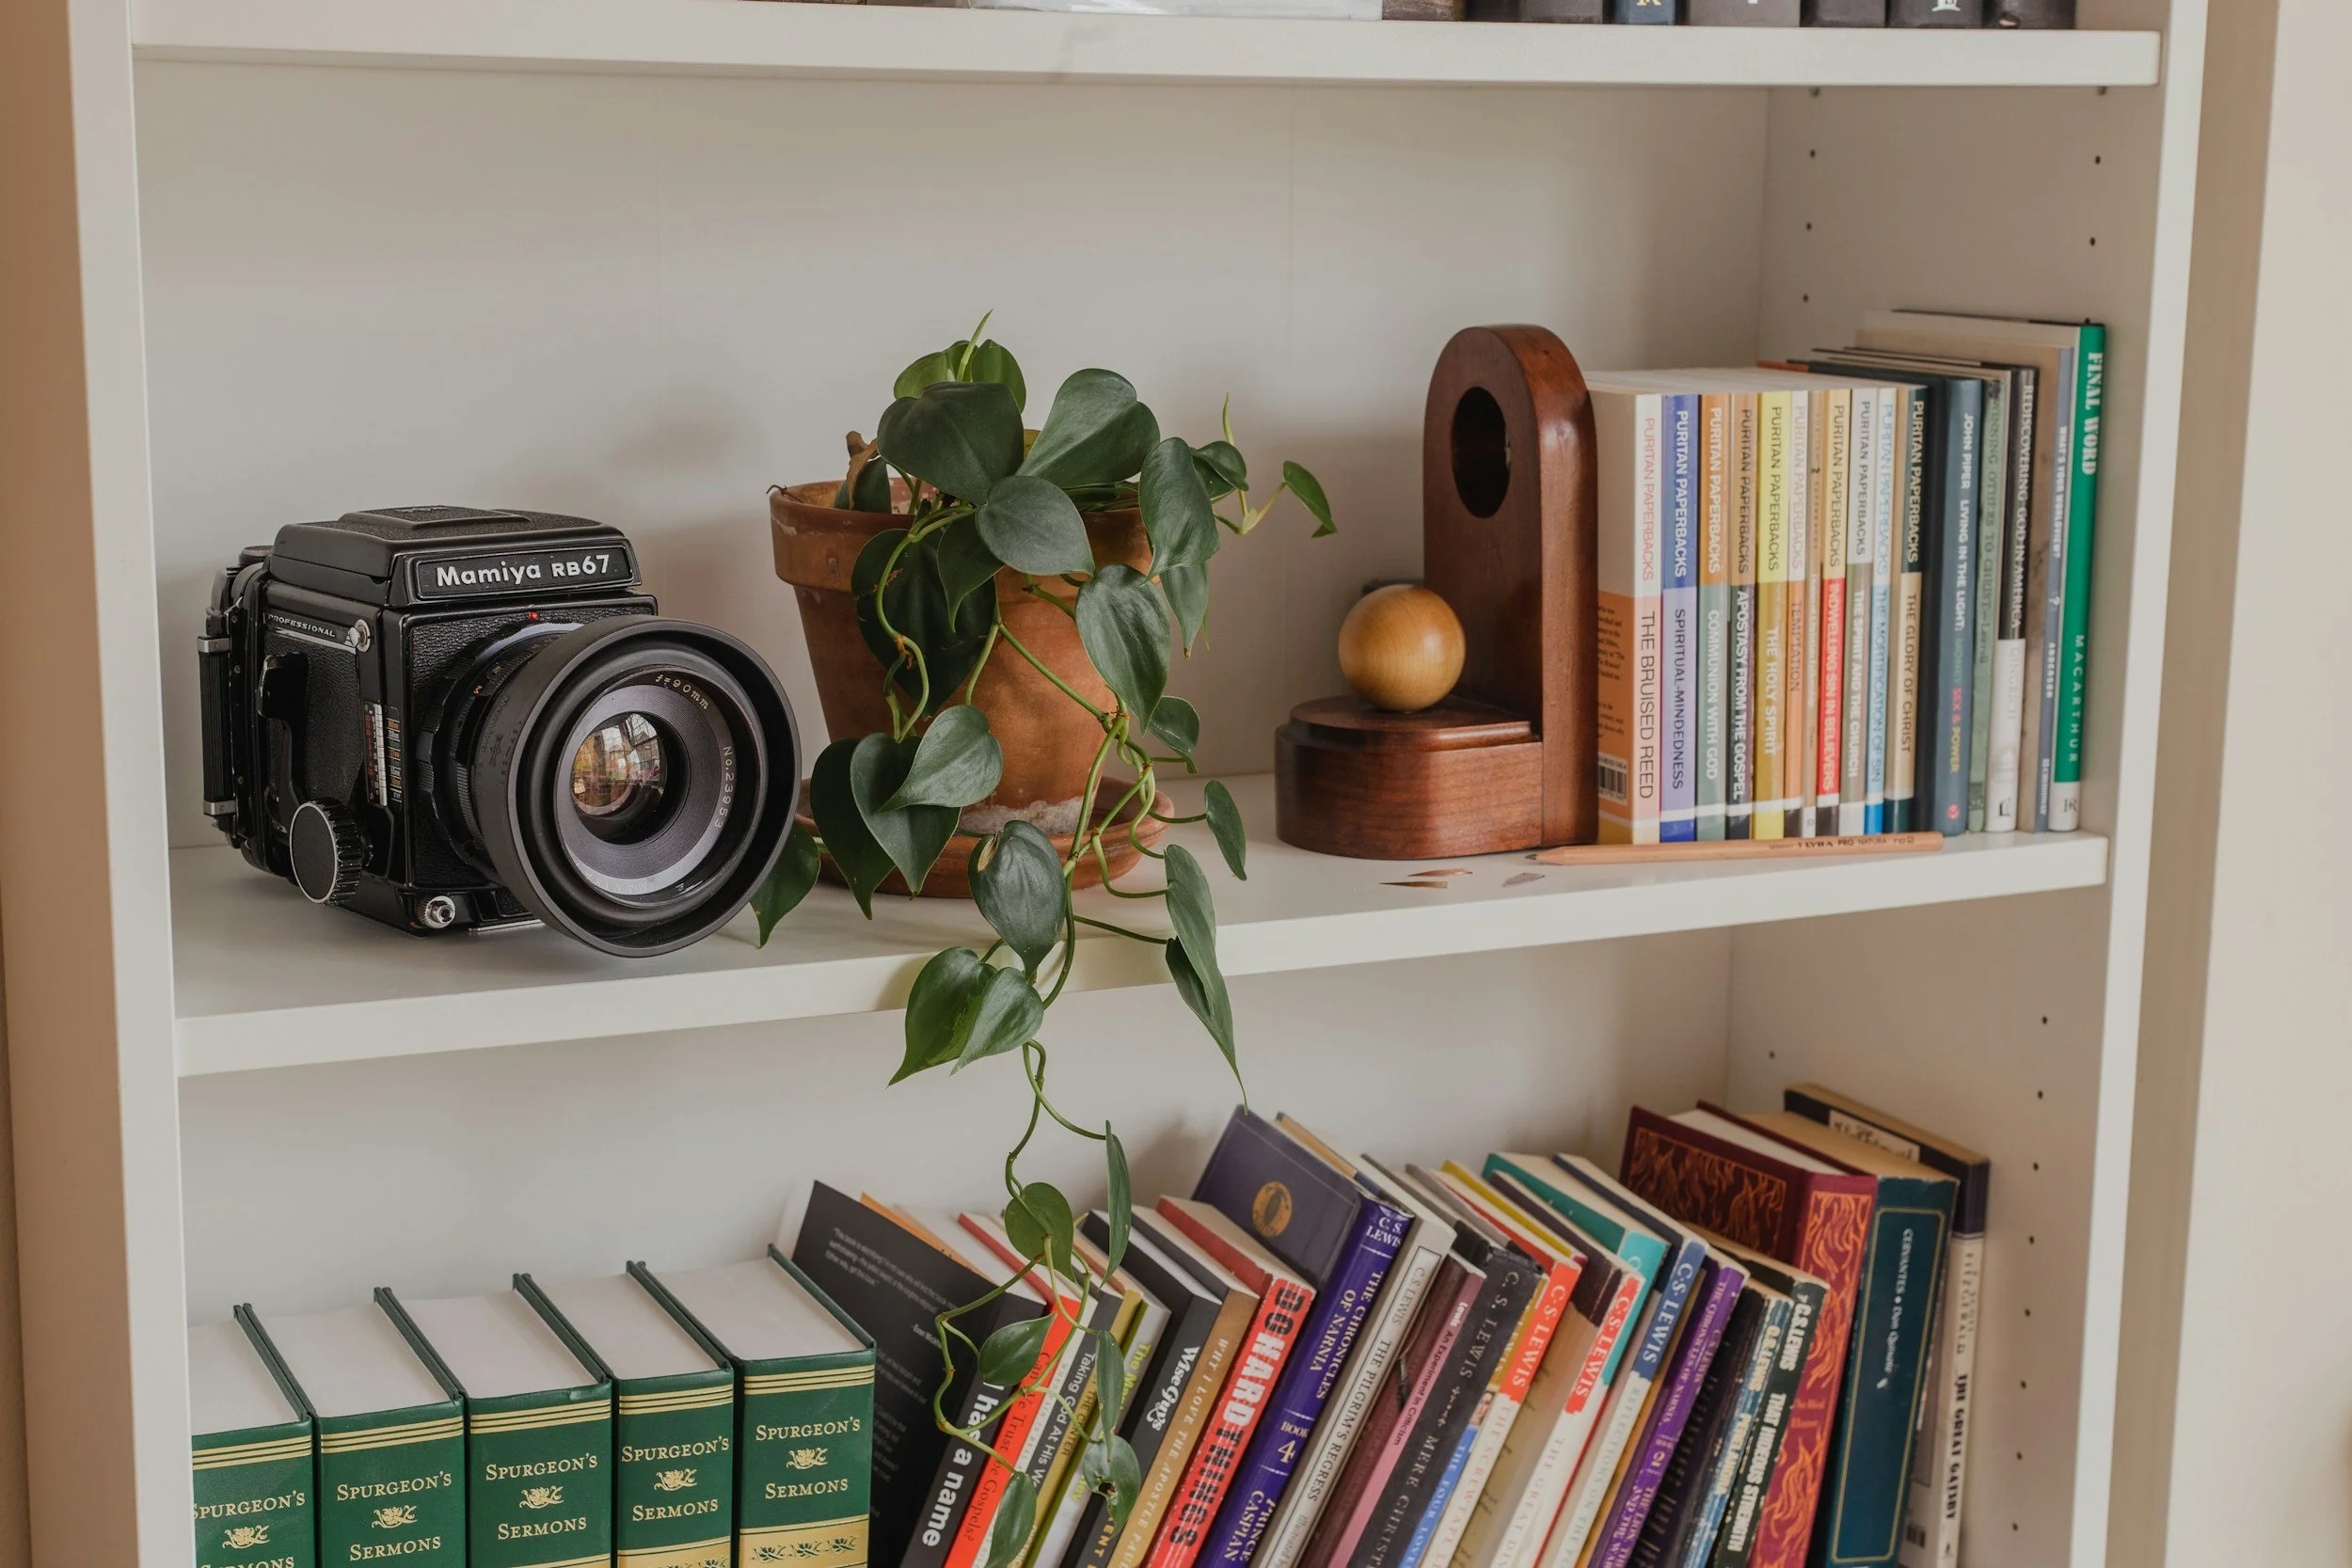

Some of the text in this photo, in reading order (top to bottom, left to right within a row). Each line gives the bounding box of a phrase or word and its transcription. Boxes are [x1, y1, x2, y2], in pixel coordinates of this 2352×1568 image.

[2058, 426, 2068, 464] WHAT'S
[2082, 352, 2103, 476] FINAL WORD
[1642, 418, 1655, 581] PURITAN PAPERBACKS
[1675, 410, 1689, 578] PURITAN PAPERBACKS
[1708, 406, 1722, 575] PURITAN PAPERBACKS
[1738, 409, 1752, 574] PURITAN PAPERBACKS
[1768, 406, 1782, 571] PURITAN PAPERBACKS
[1792, 406, 1805, 570] PURITAN PAPERBACKS
[1829, 404, 1844, 568] PURITAN PAPERBACKS
[1855, 401, 1870, 556] PURITAN PAPERBACKS
[1877, 404, 1893, 576] PURITAN PAPERBACKS
[1907, 401, 1924, 563] PURITAN PAPERBACKS
[1983, 471, 1996, 553] OTHERS TO
[2010, 385, 2033, 628] REDISCOVERING GOD IN AMERICA
[437, 555, 610, 586] Mamiya RB67
[1949, 413, 1974, 772] JOHN PIPER LIVING IN THE LIGHT: SEX POWER
[268, 614, 336, 638] PROFESSIONAL
[1790, 602, 1802, 691] TEMPTATION
[1639, 612, 1655, 799] THE BRUISED REED
[1673, 609, 1685, 789] SPIRITUAL-MINDEDNESS
[1706, 610, 1719, 780] COMMUNION WITH GOD
[1733, 590, 1749, 800] APOSTASY FROM THE GOSPEL
[1764, 628, 1778, 754] THE HOLY SPIRIT
[1822, 583, 1840, 792] INDWELLING SIN IN BELIEVERS
[1848, 590, 1865, 778] THE SPIRIT AND THE CHURCH
[1870, 590, 1887, 783] THE MORTIFICATION OF SIN
[1900, 594, 1916, 752] THE GLORY OF CHRIST
[2045, 642, 2057, 699] ANDERSON
[2068, 635, 2085, 763] MACARTHUR
[1365, 1225, 1403, 1248] LEWIS
[1310, 1289, 1357, 1373] OF NARNIA
[1315, 1270, 1382, 1400] THE CHRONICLES
[1391, 1290, 1414, 1326] LEWIS
[1446, 1329, 1454, 1343] An
[1450, 1302, 1469, 1327] Lewis
[1460, 1271, 1519, 1379] C. S. LEWIS
[1642, 1299, 1680, 1364] LEWIS
[1680, 1281, 1727, 1383] THE CHRONICLES OF
[1883, 1228, 1914, 1373] CERVANTES Don Quixote
[1068, 1353, 1096, 1392] Taking
[1129, 1342, 1152, 1371] The
[1370, 1339, 1391, 1370] THE
[1418, 1342, 1448, 1396] Experiment
[1512, 1323, 1550, 1387] LEWIS
[1575, 1335, 1613, 1398] LEWIS
[755, 1416, 861, 1442] SPURGEON'S
[1001, 1414, 1026, 1452] Trust
[1047, 1424, 1063, 1443] At
[1057, 1395, 1075, 1425] God
[1083, 1390, 1097, 1410] THE
[1136, 1338, 1229, 1528] WHY I LOVE THE APOSTLE
[1169, 1287, 1306, 1548] DO HARD THINGS
[1280, 1420, 1310, 1438] BOOK
[1329, 1370, 1375, 1449] PILGRIM'S
[1393, 1404, 1417, 1446] Criticism
[1414, 1394, 1422, 1405] in
[485, 1452, 598, 1481] SPURGEON'S
[621, 1435, 730, 1463] SPURGEON'S
[1038, 1441, 1057, 1465] His
[1278, 1440, 1296, 1464] 4
[1306, 1440, 1342, 1502] REGRESS
[1406, 1434, 1441, 1488] MERE
[1427, 1444, 1465, 1517] THE FOUR
[1440, 1405, 1510, 1545] THE SCREWTAPE
[1570, 1387, 1641, 1542] REFLECTIONS ON THE
[1716, 1414, 1752, 1496] PERELANDRA
[1727, 1392, 1787, 1552] THAT HIDEOUS STRENGTH
[1946, 1373, 1967, 1520] THE GREAT GATSBY
[337, 1471, 452, 1502] SPURGEON'S
[632, 1497, 719, 1523] SERMONS
[765, 1478, 849, 1500] SERMONS
[922, 1448, 972, 1548] a name
[963, 1480, 998, 1543] Gospels?
[1514, 1437, 1566, 1536] THE GREAT
[1613, 1485, 1643, 1540] AND THE
[1641, 1486, 1655, 1506] THE
[350, 1536, 441, 1561] SERMONS
[498, 1516, 587, 1541] SERMONS
[1224, 1489, 1265, 1561] CASPIAN
[1239, 1497, 1277, 1561] PRINCE
